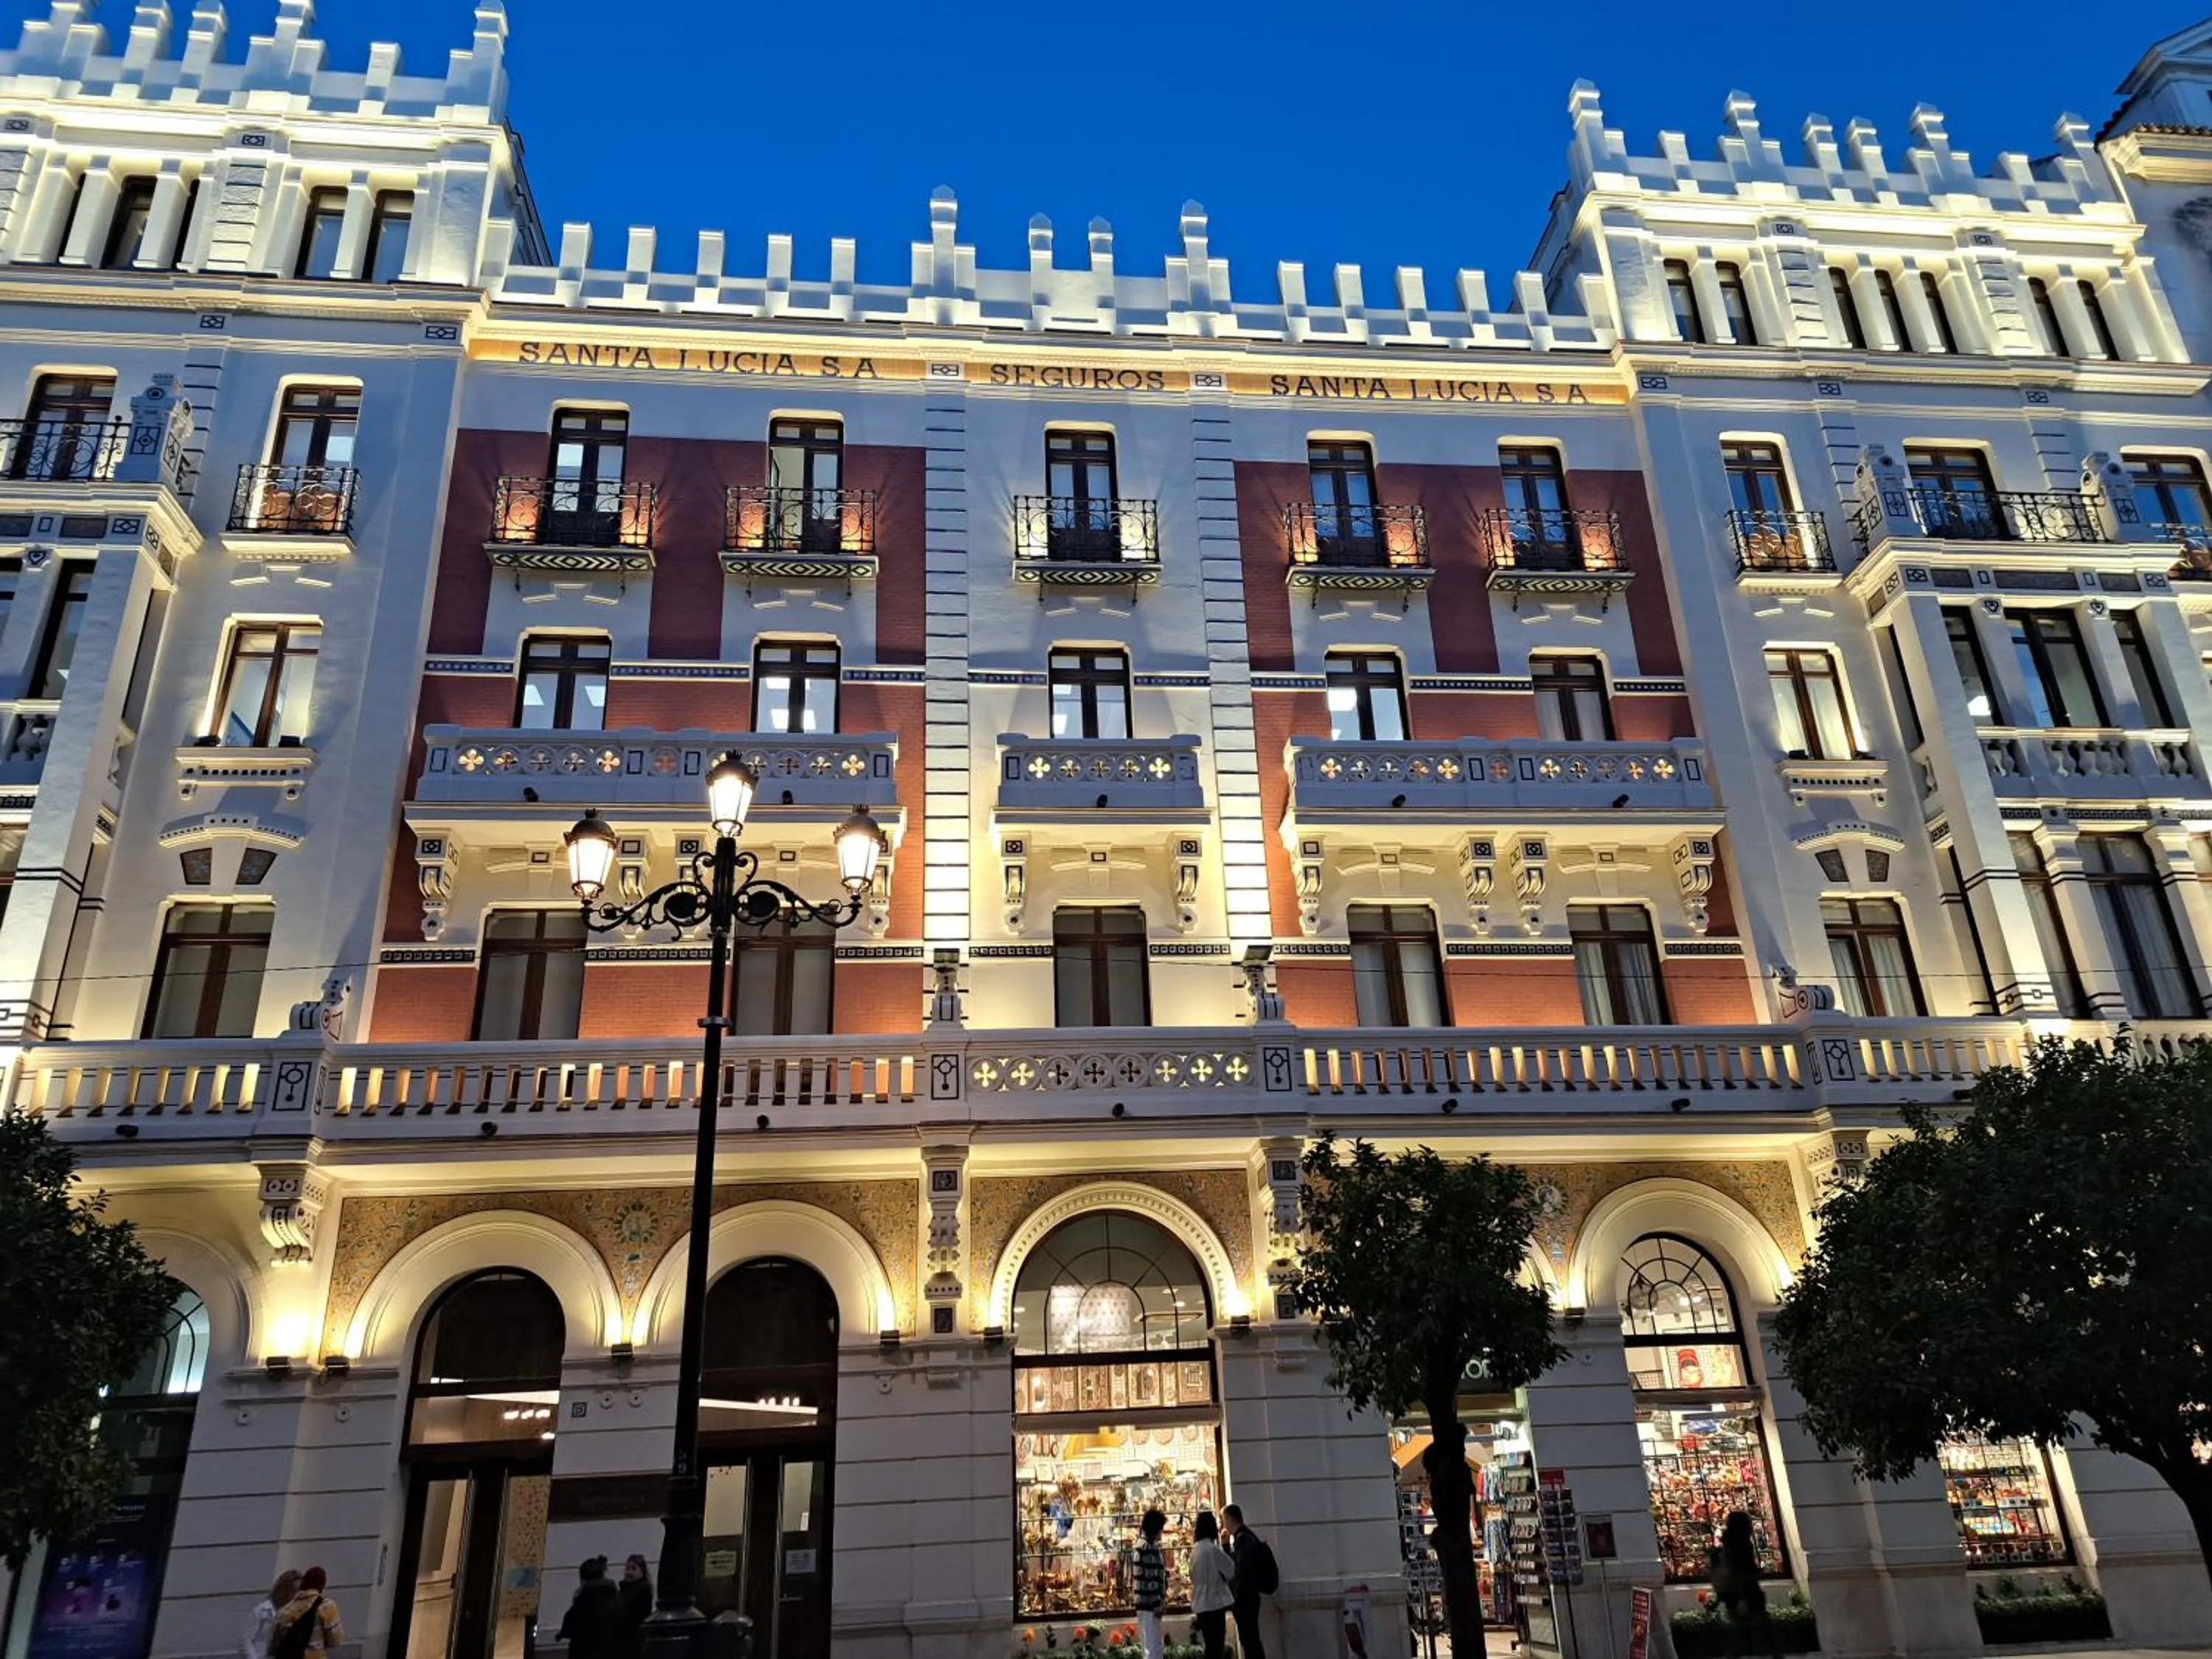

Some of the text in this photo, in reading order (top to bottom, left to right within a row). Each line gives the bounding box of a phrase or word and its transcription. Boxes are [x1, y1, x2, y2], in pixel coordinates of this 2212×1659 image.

[519, 341, 654, 368] SANTA
[990, 364, 1165, 390] SEGUROS
[1270, 375, 1391, 399] SANTA
